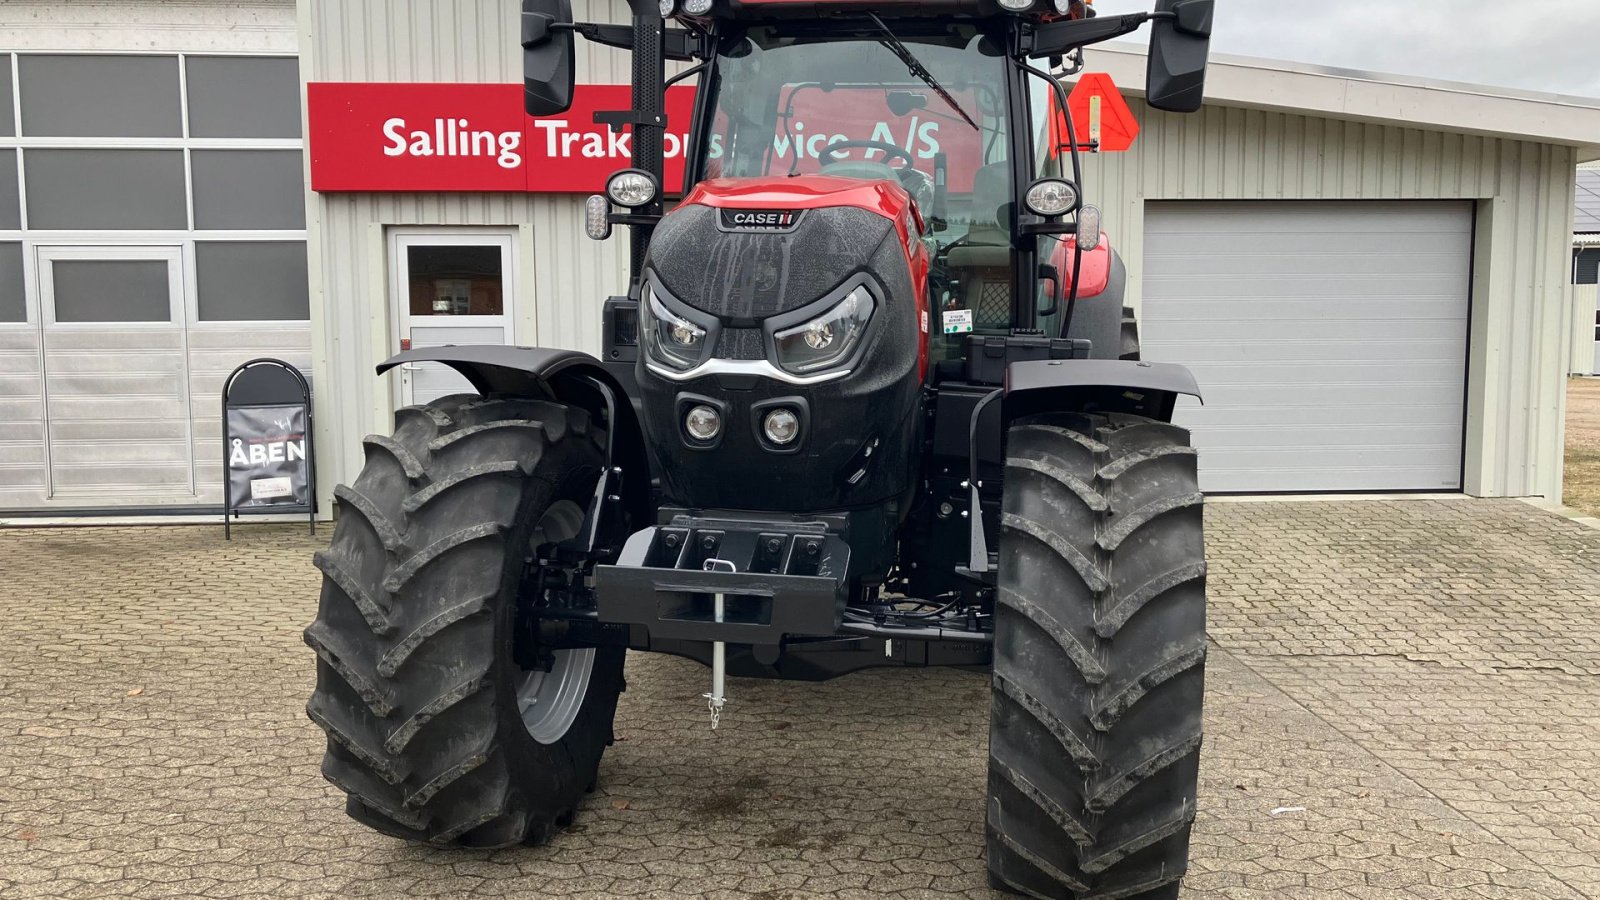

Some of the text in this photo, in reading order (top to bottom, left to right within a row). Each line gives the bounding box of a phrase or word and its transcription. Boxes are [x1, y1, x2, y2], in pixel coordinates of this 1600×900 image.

[382, 117, 522, 169] Salling
[864, 115, 941, 159] A/S
[734, 213, 777, 224] CASE
[229, 438, 305, 467] ÅBEN
